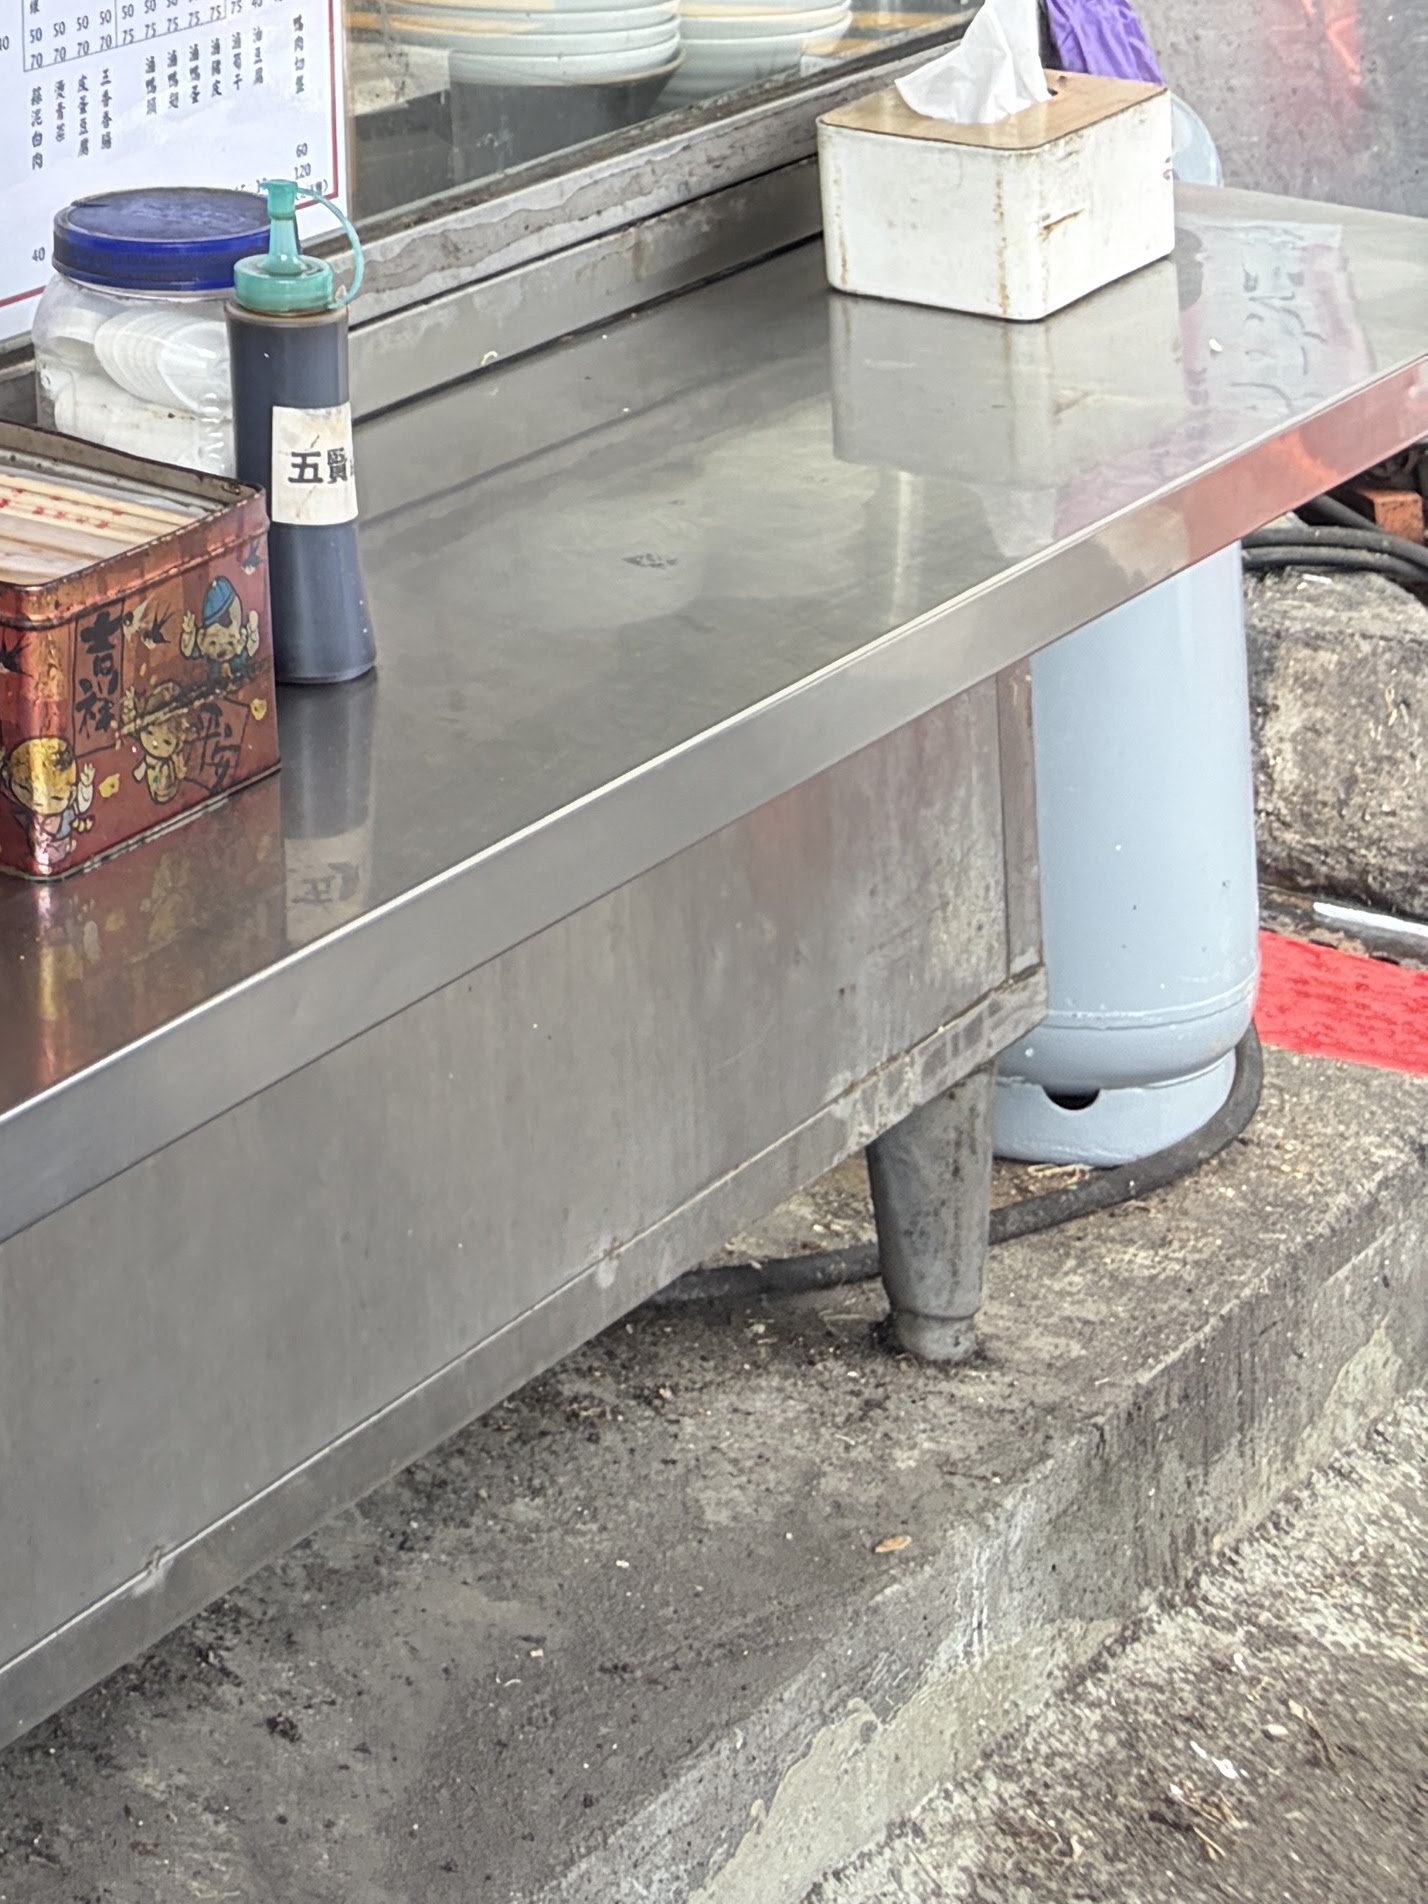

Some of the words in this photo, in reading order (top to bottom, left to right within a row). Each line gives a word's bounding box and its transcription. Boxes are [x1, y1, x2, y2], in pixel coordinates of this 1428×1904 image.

[29, 28, 43, 44] 50
[53, 20, 66, 37] 50
[76, 15, 89, 31] 50
[99, 9, 112, 25] 50
[122, 3, 134, 20] 50
[30, 52, 43, 70] 70
[53, 46, 66, 63] 70
[77, 40, 89, 57] 70
[100, 34, 112, 51] 70
[122, 28, 134, 45] 75
[145, 22, 157, 39] 75
[167, 17, 179, 33] 75
[188, 11, 200, 27] 75
[210, 5, 222, 22] 75
[231, 0, 242, 15] 75
[296, 143, 308, 158] 60
[294, 163, 311, 180] 120
[32, 247, 46, 262] 40
[287, 446, 354, 484] 五賢
